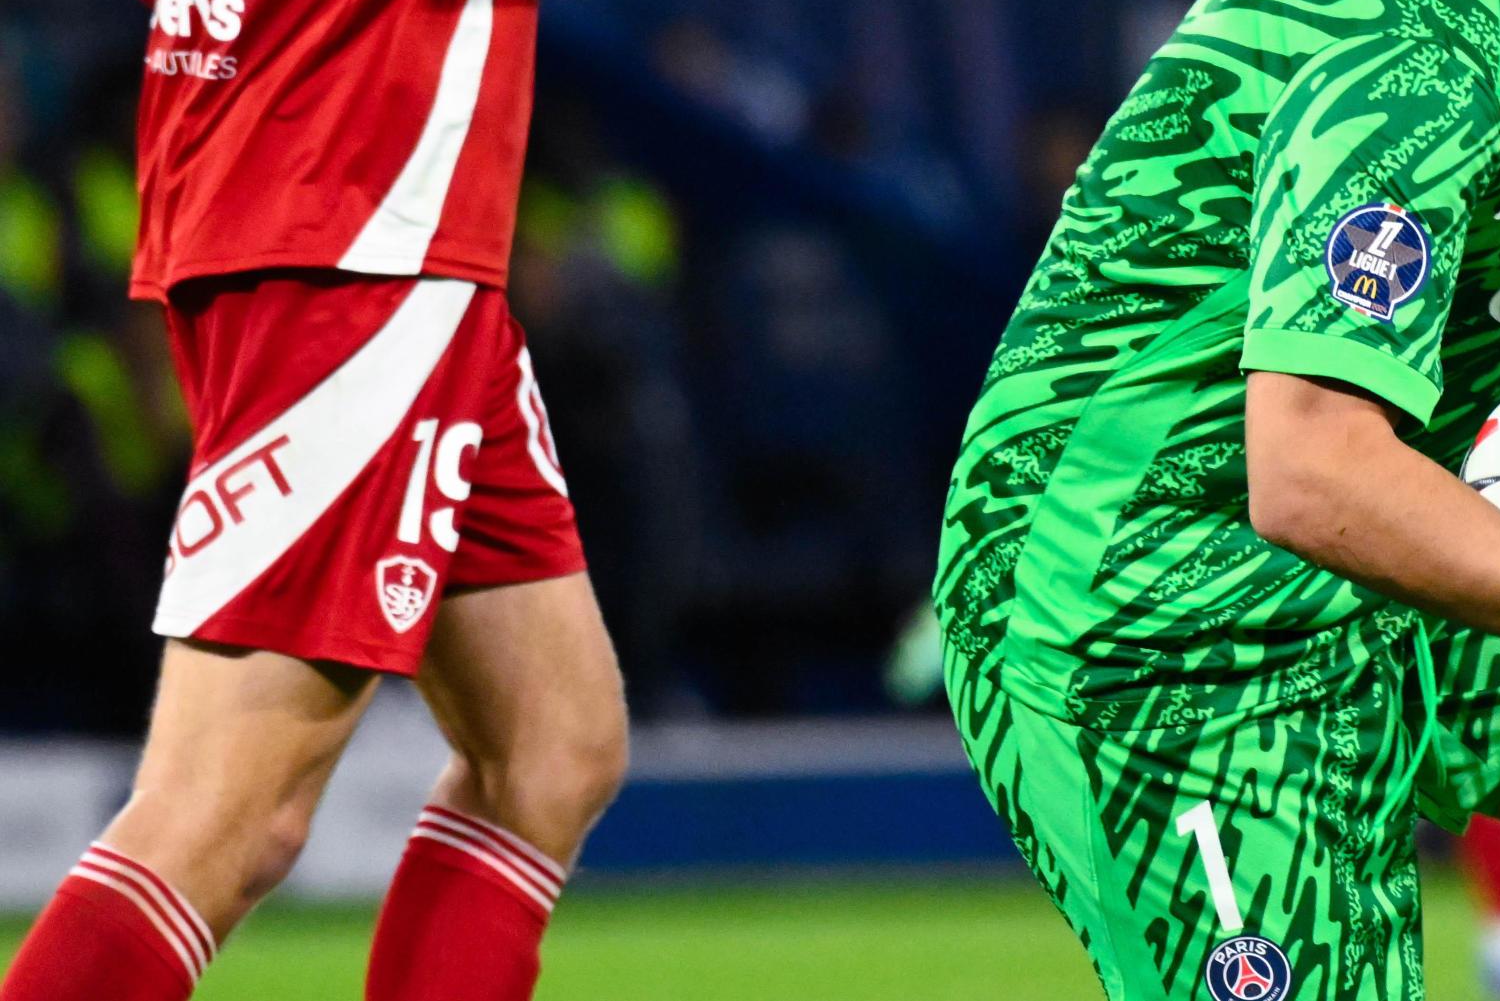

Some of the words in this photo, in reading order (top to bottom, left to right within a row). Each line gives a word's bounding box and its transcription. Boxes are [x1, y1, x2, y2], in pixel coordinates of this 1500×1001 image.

[165, 434, 293, 580] OFT
[397, 417, 483, 553] 19
[1175, 799, 1244, 932] 1
[1214, 940, 1268, 966] PARIS
